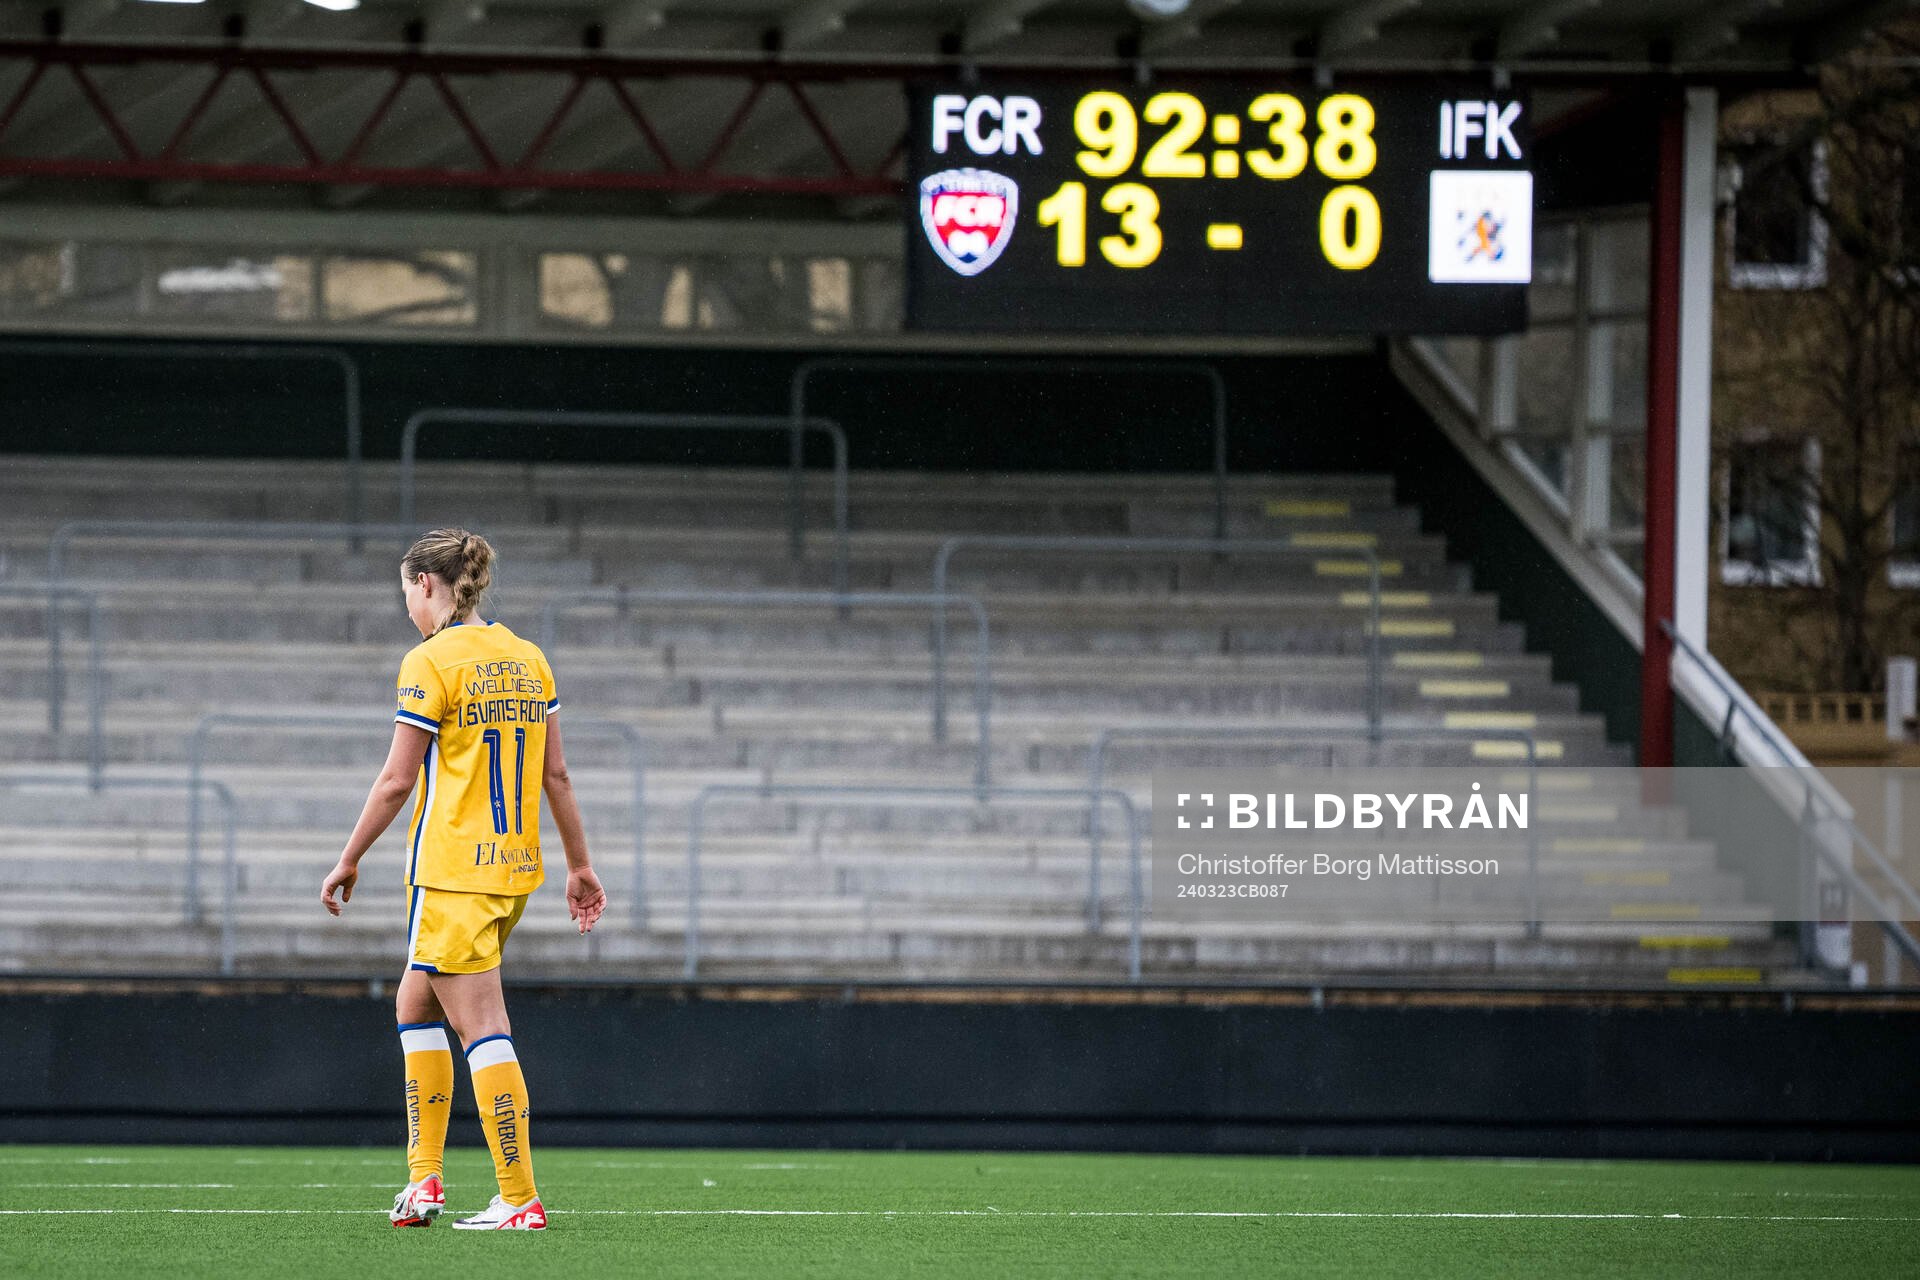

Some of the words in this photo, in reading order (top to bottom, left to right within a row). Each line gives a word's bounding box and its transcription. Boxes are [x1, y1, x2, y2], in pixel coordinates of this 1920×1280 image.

[932, 95, 1042, 155] FCR
[1073, 90, 1377, 179] 92:38
[1439, 100, 1523, 159] IFK
[1037, 182, 1162, 268] 13
[1319, 185, 1382, 270] 0
[398, 684, 425, 699] orris
[465, 678, 543, 696] WELLNESS
[475, 662, 528, 677] NORDC
[458, 697, 546, 728] I.SVANSRÖM
[482, 728, 526, 836] 11
